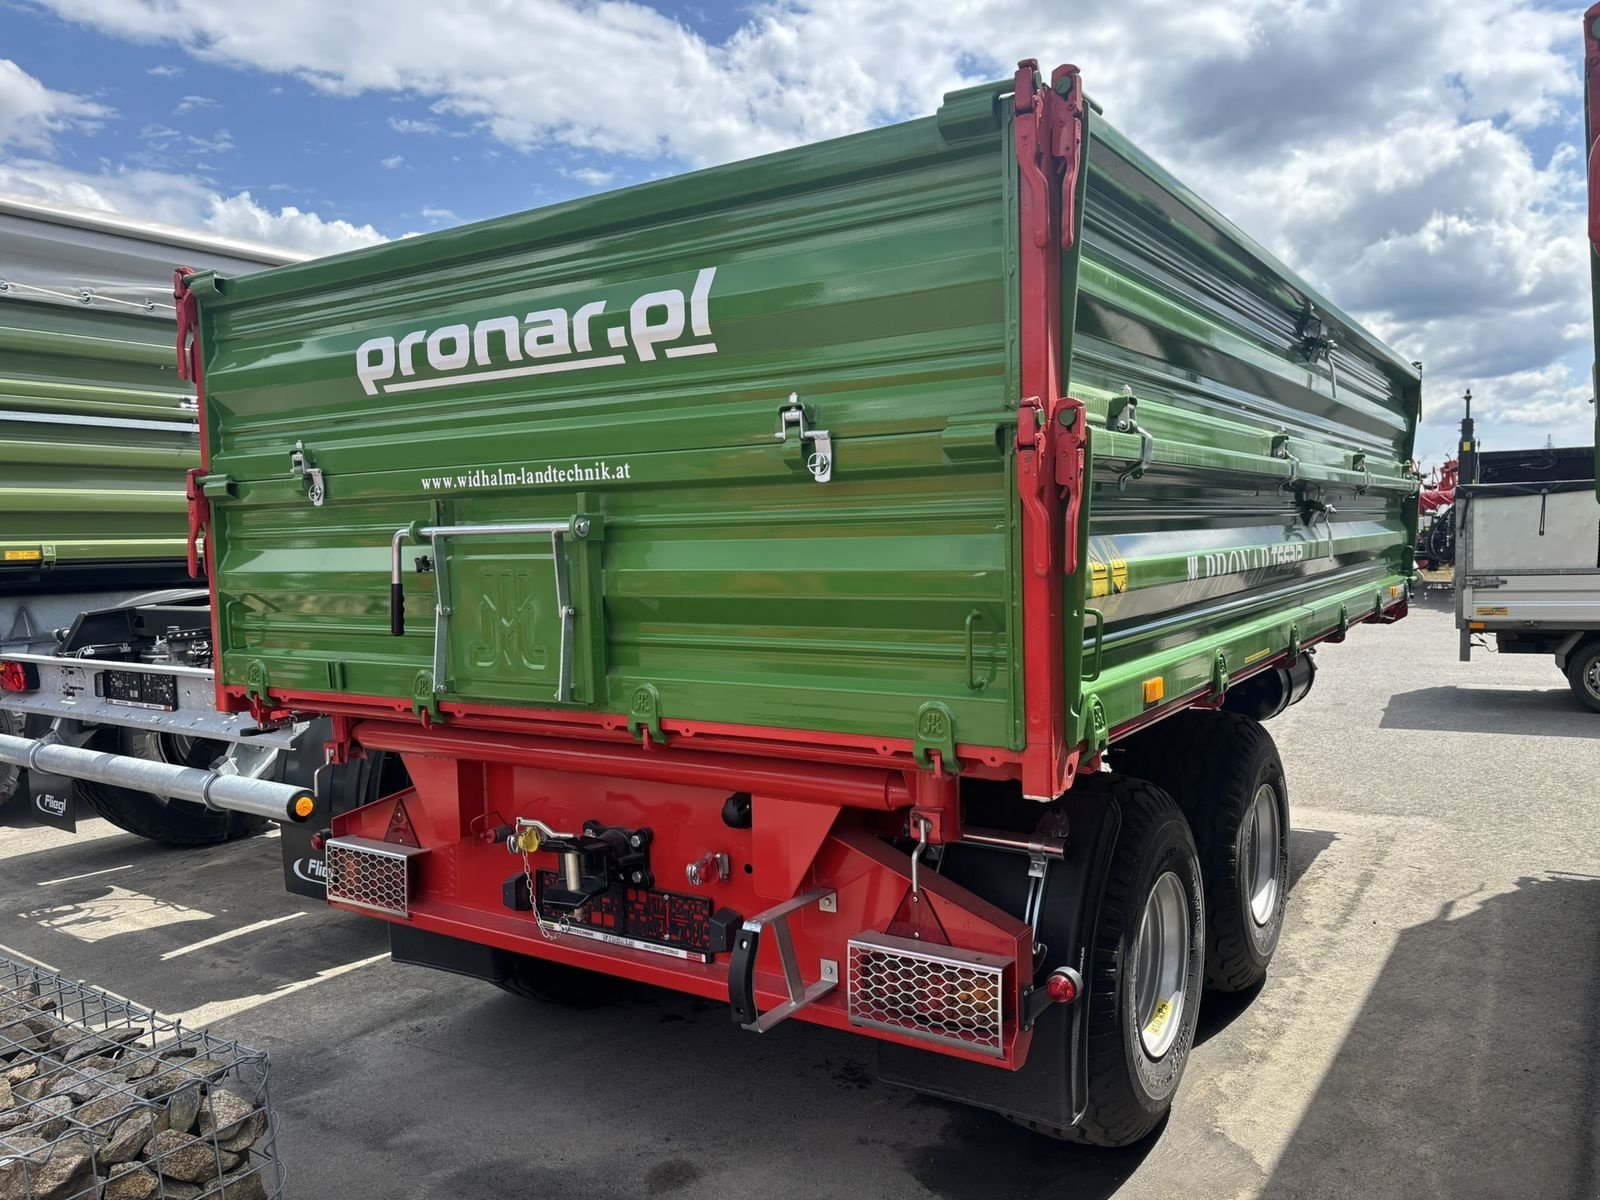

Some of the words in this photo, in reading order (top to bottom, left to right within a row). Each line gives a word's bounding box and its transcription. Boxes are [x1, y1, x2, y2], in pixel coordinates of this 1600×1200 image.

[356, 267, 718, 395] pronar.pl
[421, 462, 631, 490] www.widhalm-landtechnik.at
[45, 794, 67, 814] Fliegl
